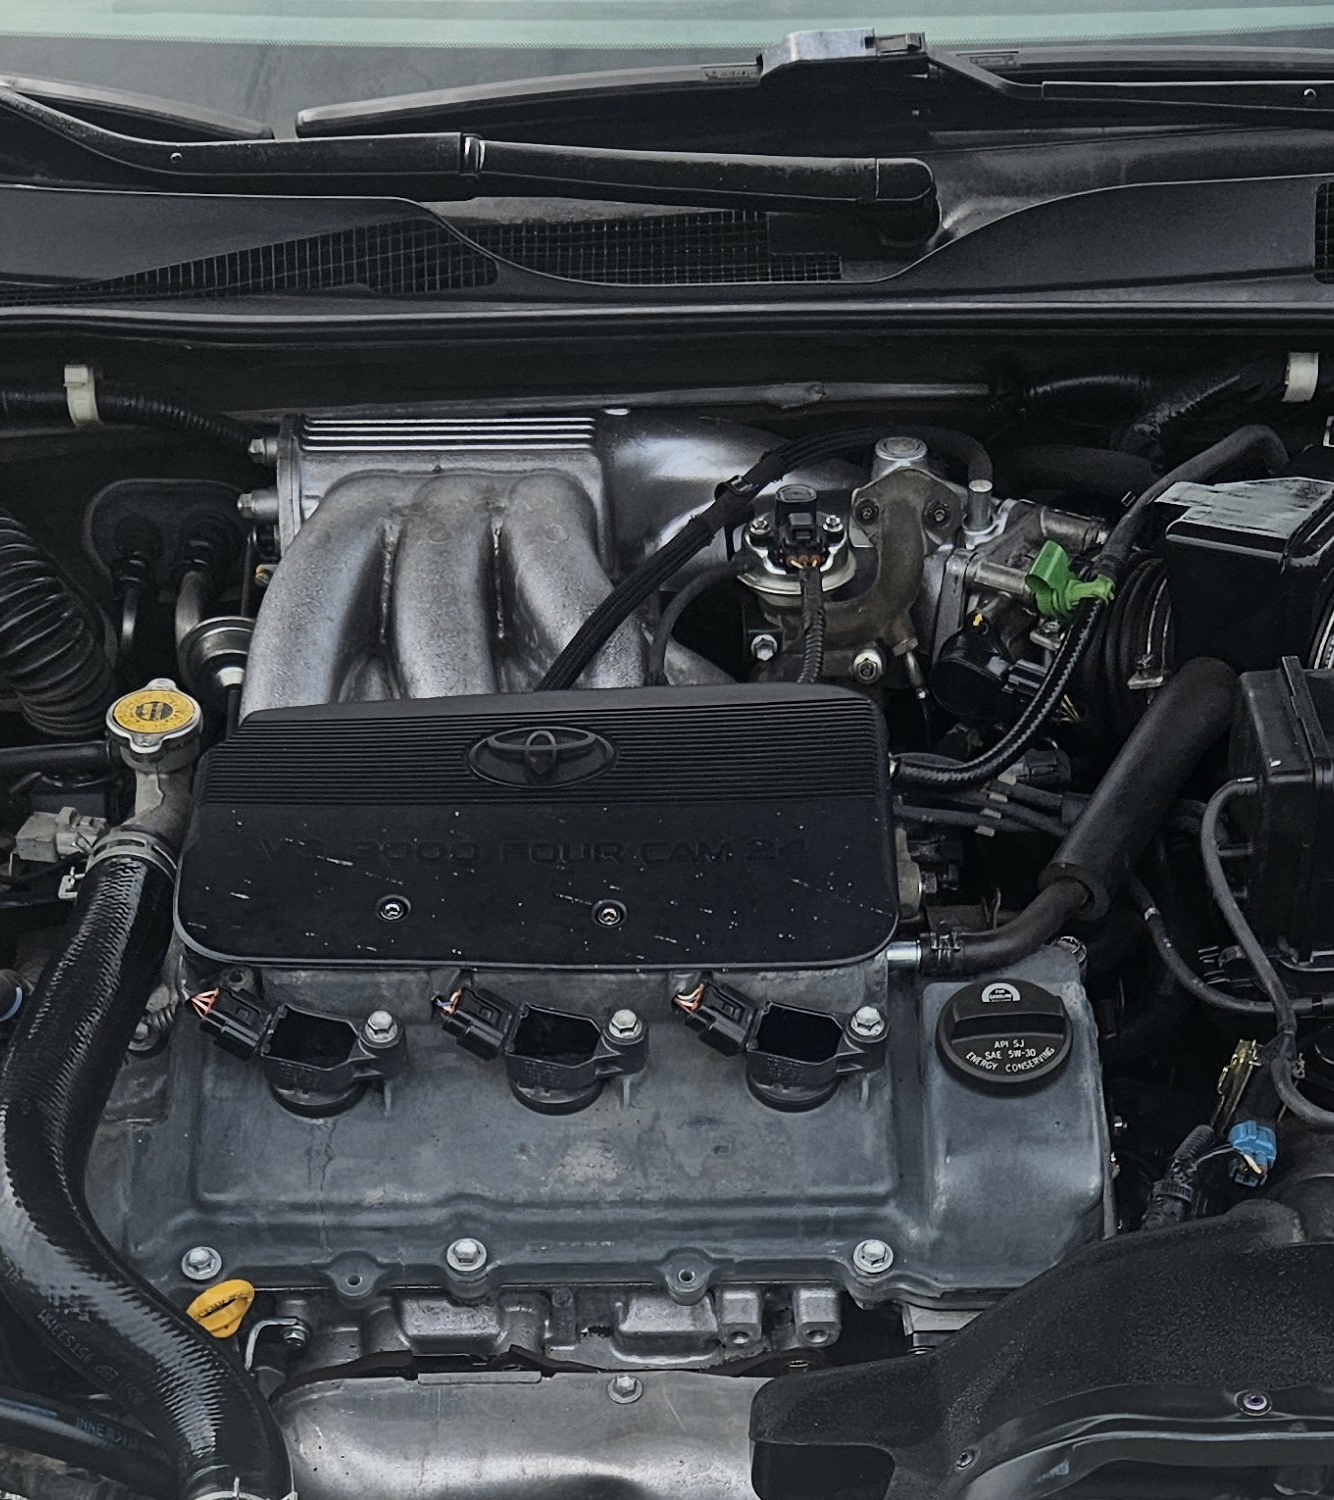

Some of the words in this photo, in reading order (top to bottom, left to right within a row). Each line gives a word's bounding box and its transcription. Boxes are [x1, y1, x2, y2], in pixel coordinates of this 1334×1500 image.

[501, 840, 624, 863] FOUR
[641, 840, 735, 863] CAM
[994, 1040, 1009, 1049] API
[1013, 1039, 1025, 1048] SJ
[965, 1051, 999, 1071] ENERGY
[1005, 1046, 1055, 1073] CONSERVING
[985, 1050, 1002, 1060] SAE
[1008, 1049, 1037, 1059] 5W-30
